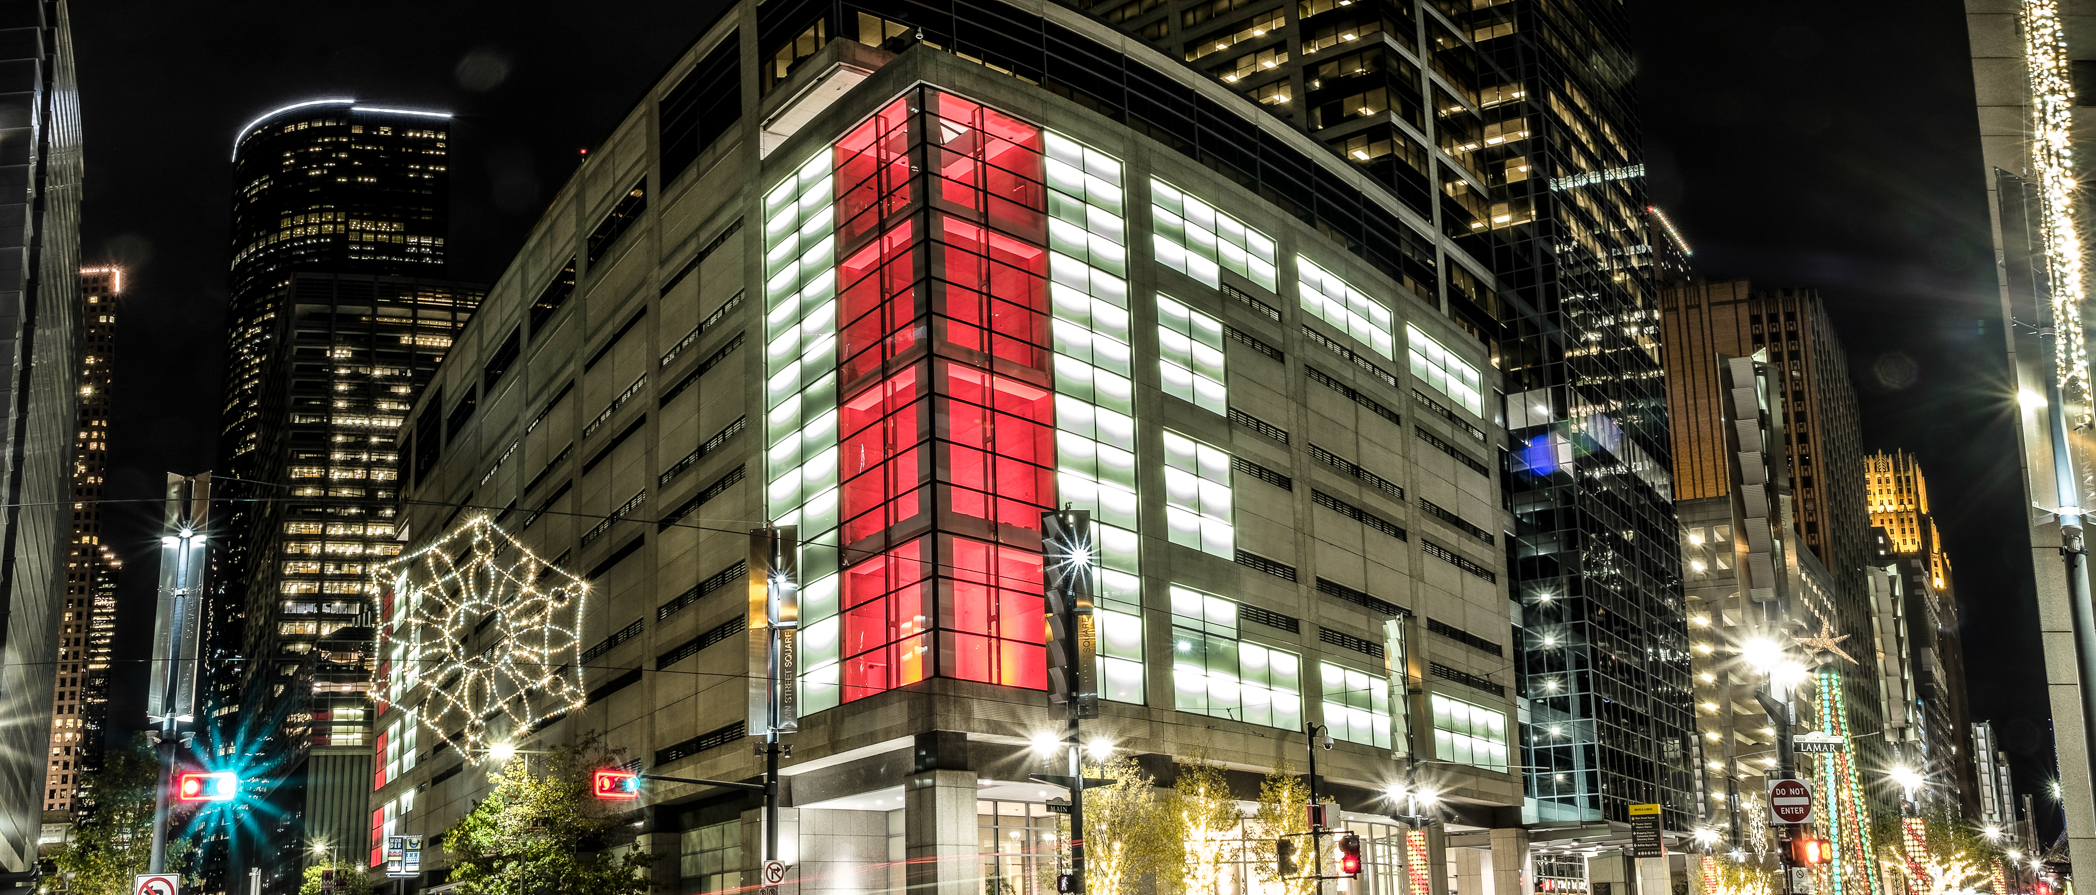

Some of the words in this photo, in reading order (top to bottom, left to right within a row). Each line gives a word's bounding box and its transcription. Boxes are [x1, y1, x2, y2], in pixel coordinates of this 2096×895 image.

[1082, 617, 1091, 653] SQUARE
[784, 631, 793, 668] SQUARE
[784, 669, 793, 703] STREET
[1800, 742, 1837, 753] LAMAR
[1775, 788, 1786, 796] DO
[1789, 787, 1805, 795] NOT
[1050, 805, 1068, 813] MAIN
[1780, 806, 1805, 815] ENTER
